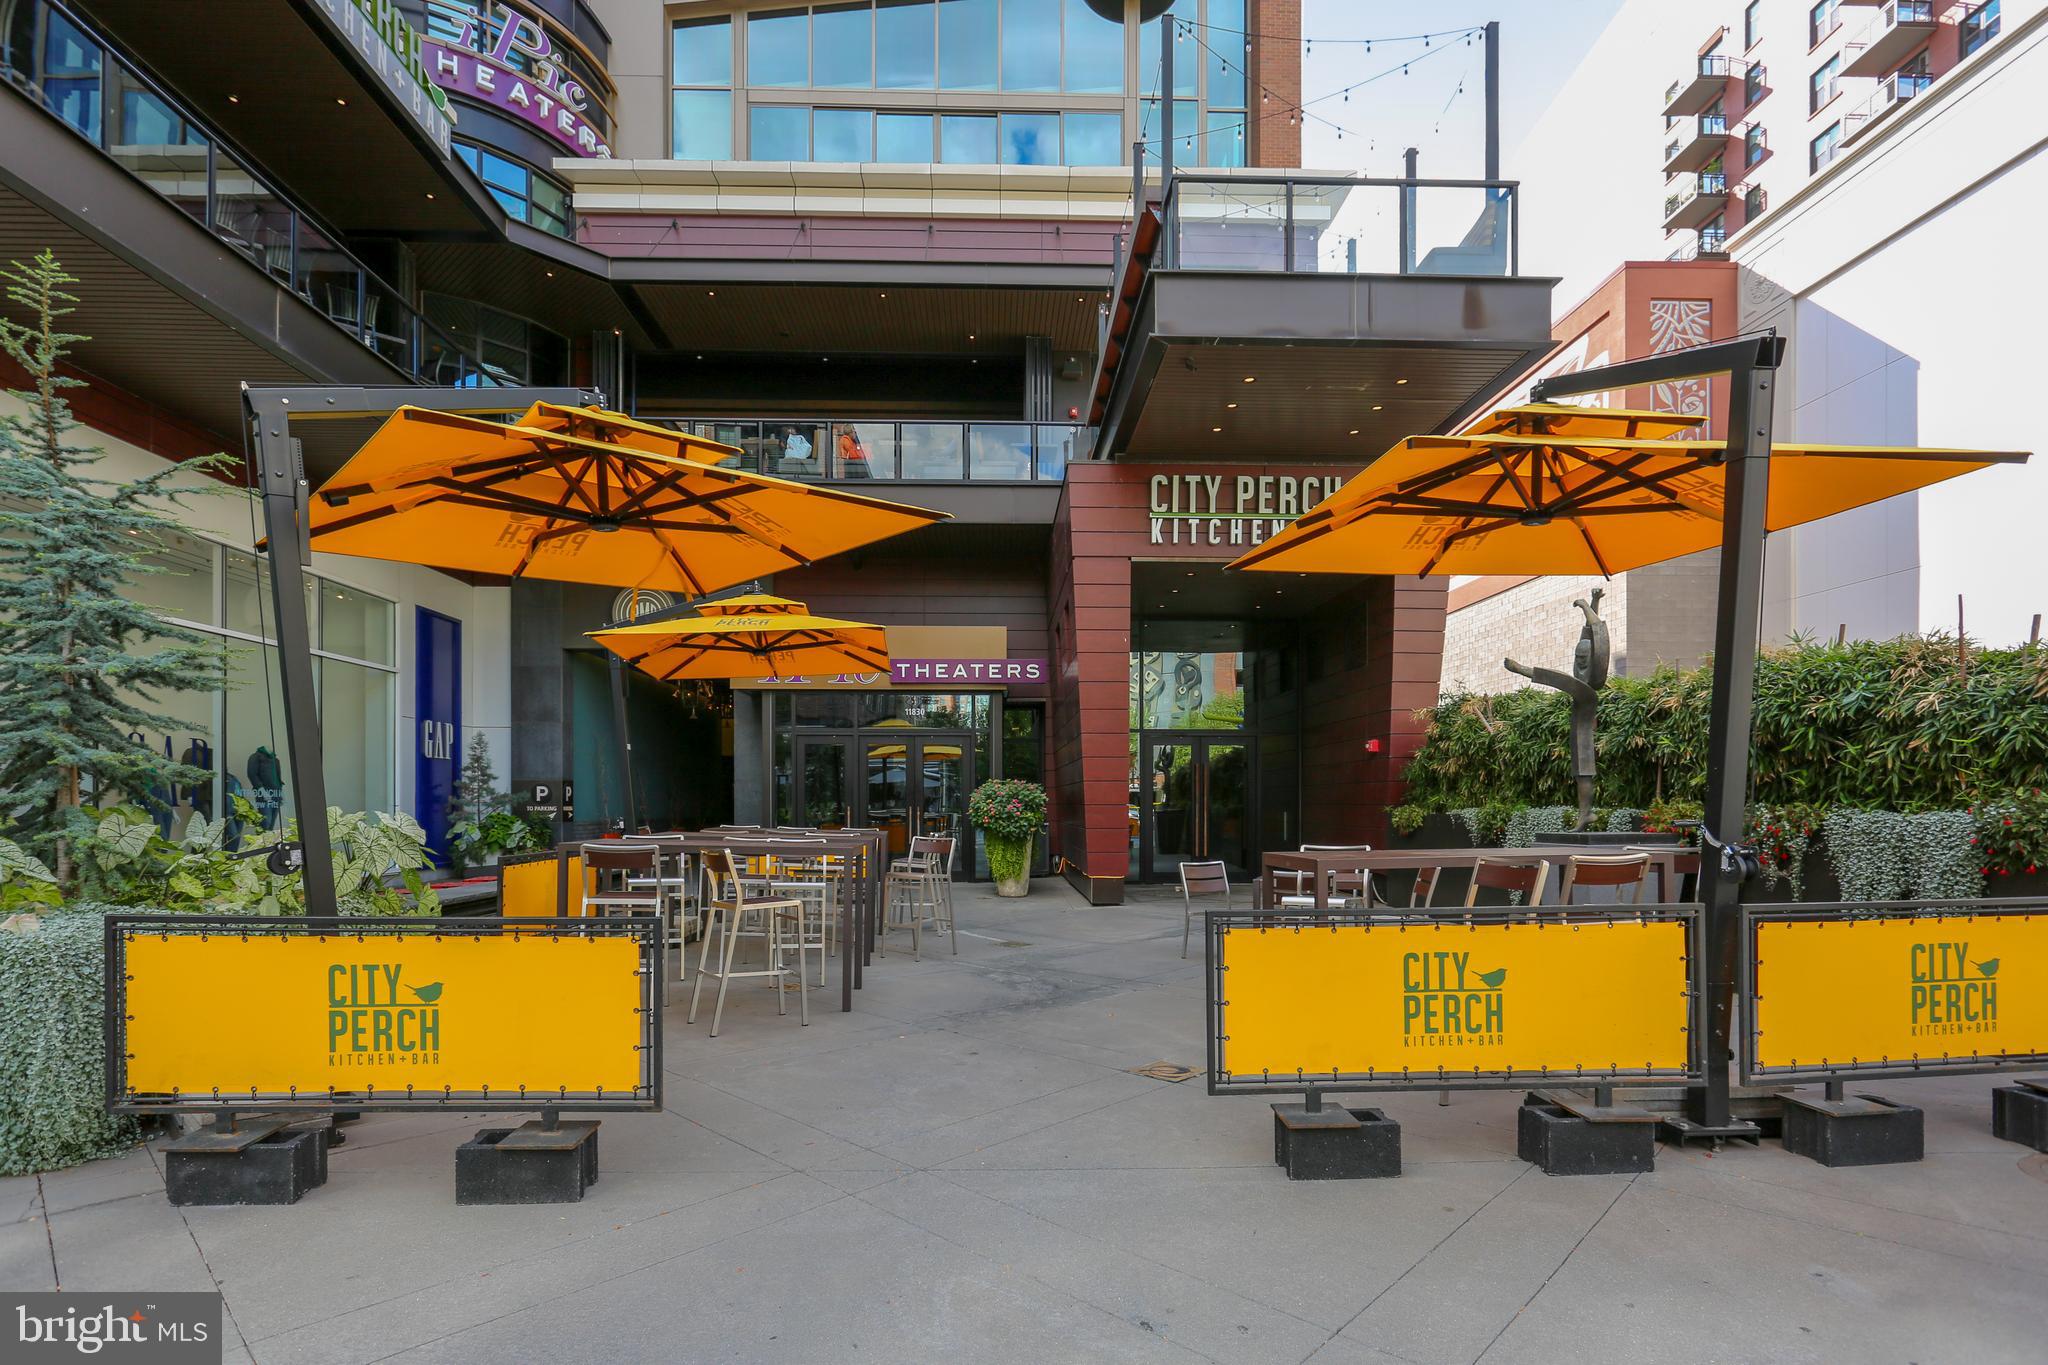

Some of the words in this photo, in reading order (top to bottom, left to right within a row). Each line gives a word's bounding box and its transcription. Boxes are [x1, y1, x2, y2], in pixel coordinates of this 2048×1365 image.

[450, 3, 589, 113] iPic
[437, 50, 612, 159] HEATERS
[1151, 474, 1223, 513] CITY
[896, 663, 1041, 679] THEATERS
[905, 708, 925, 716] 11830
[424, 719, 454, 760] GAP
[535, 785, 549, 802] P
[565, 786, 573, 802] P
[1403, 952, 1470, 992] CITY
[1911, 942, 1968, 982] CITY
[328, 964, 402, 1007] CITY
[1911, 982, 1996, 1024] PERCH
[328, 1008, 439, 1053] PERCH
[1403, 993, 1503, 1035] PERCH
